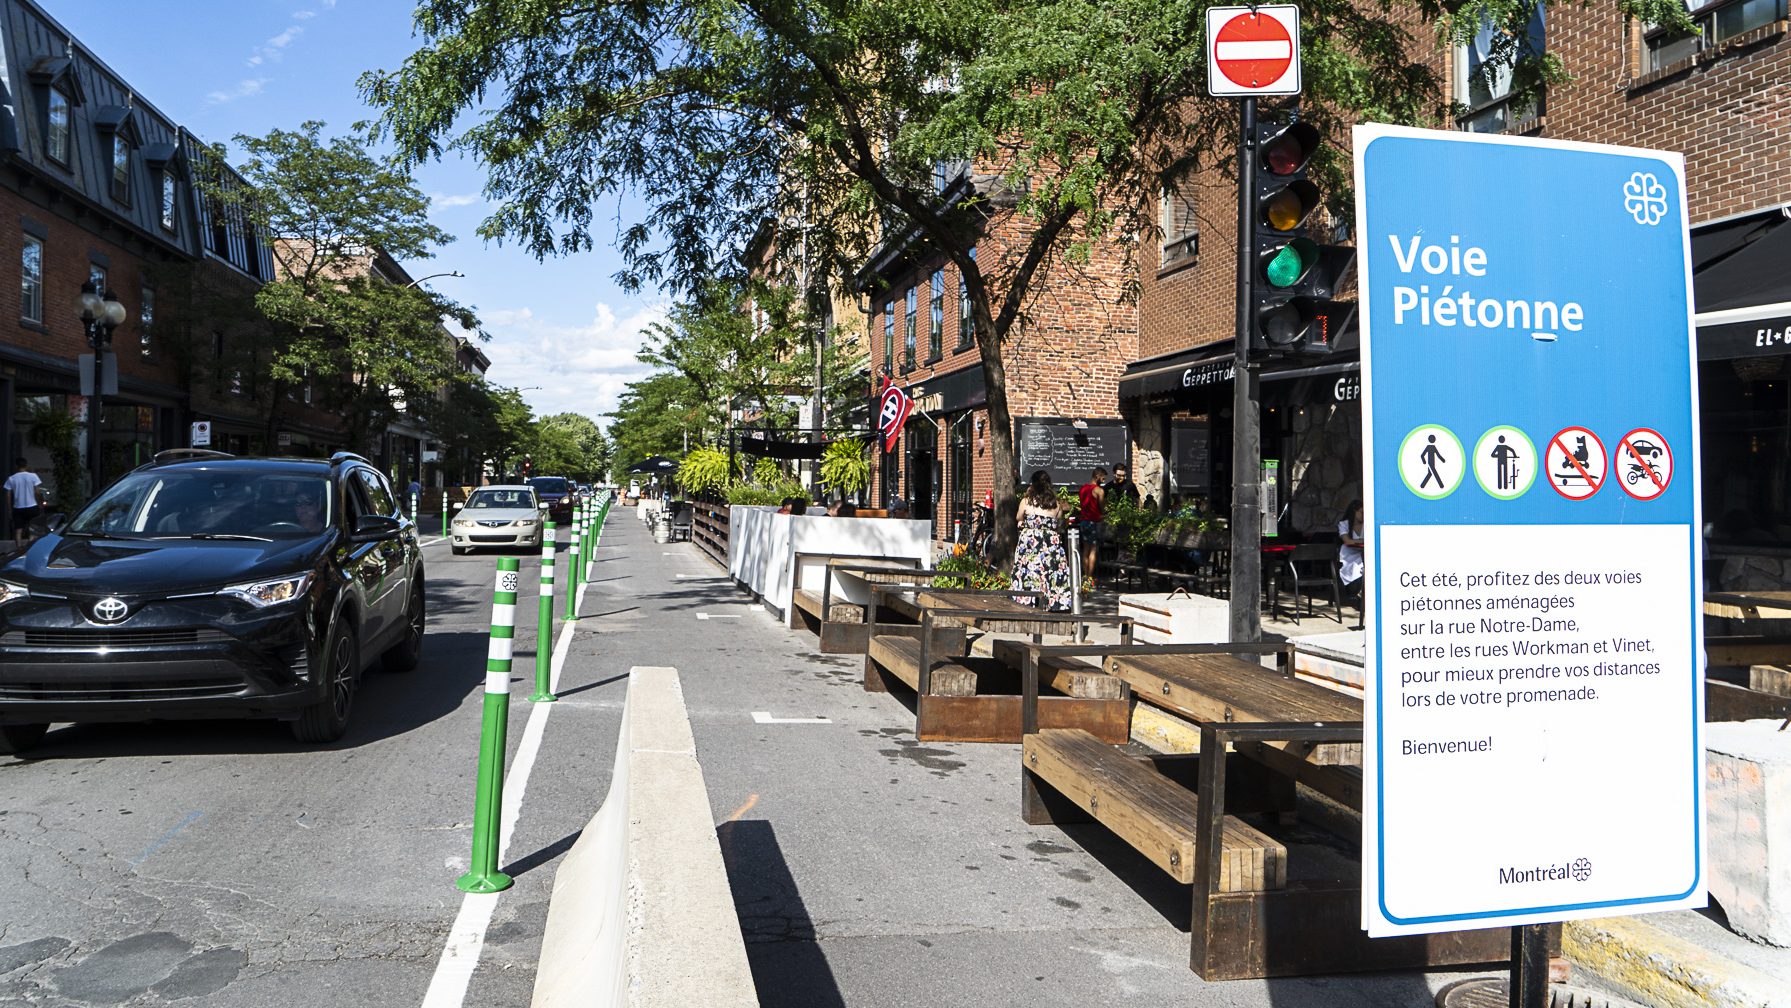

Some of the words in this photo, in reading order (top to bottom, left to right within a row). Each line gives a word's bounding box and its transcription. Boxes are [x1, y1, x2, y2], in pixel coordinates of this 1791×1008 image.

[1388, 234, 1488, 277] Voie
[1393, 285, 1584, 332] Piétonne
[1400, 572, 1427, 587] Cet
[1432, 573, 1461, 588] été,
[1467, 571, 1529, 590] profitez
[1535, 571, 1559, 585] des
[1565, 571, 1600, 584] deux
[1605, 570, 1641, 584] voies
[1401, 597, 1481, 615] piétonnes
[1487, 595, 1574, 613] aménagées
[1401, 624, 1425, 635] sur
[1431, 620, 1443, 634] la
[1449, 623, 1475, 634] rue
[1481, 617, 1579, 633] Notre-Dame,
[1401, 646, 1444, 659] entre
[1451, 643, 1470, 657] les
[1476, 645, 1508, 656] rues
[1513, 641, 1588, 655] Workman
[1594, 641, 1608, 653] et
[1613, 638, 1654, 652] Vinet,
[1402, 671, 1440, 687] pour
[1446, 667, 1493, 681] mieux
[1499, 664, 1560, 684] prendre
[1565, 666, 1589, 677] vos
[1594, 662, 1660, 676] distances
[1403, 693, 1430, 707] lors
[1436, 691, 1455, 705] de
[1460, 691, 1501, 704] votre
[1507, 686, 1599, 707] promenade.
[1403, 736, 1492, 755] Bienvenue!
[1499, 863, 1570, 884] Montréal
